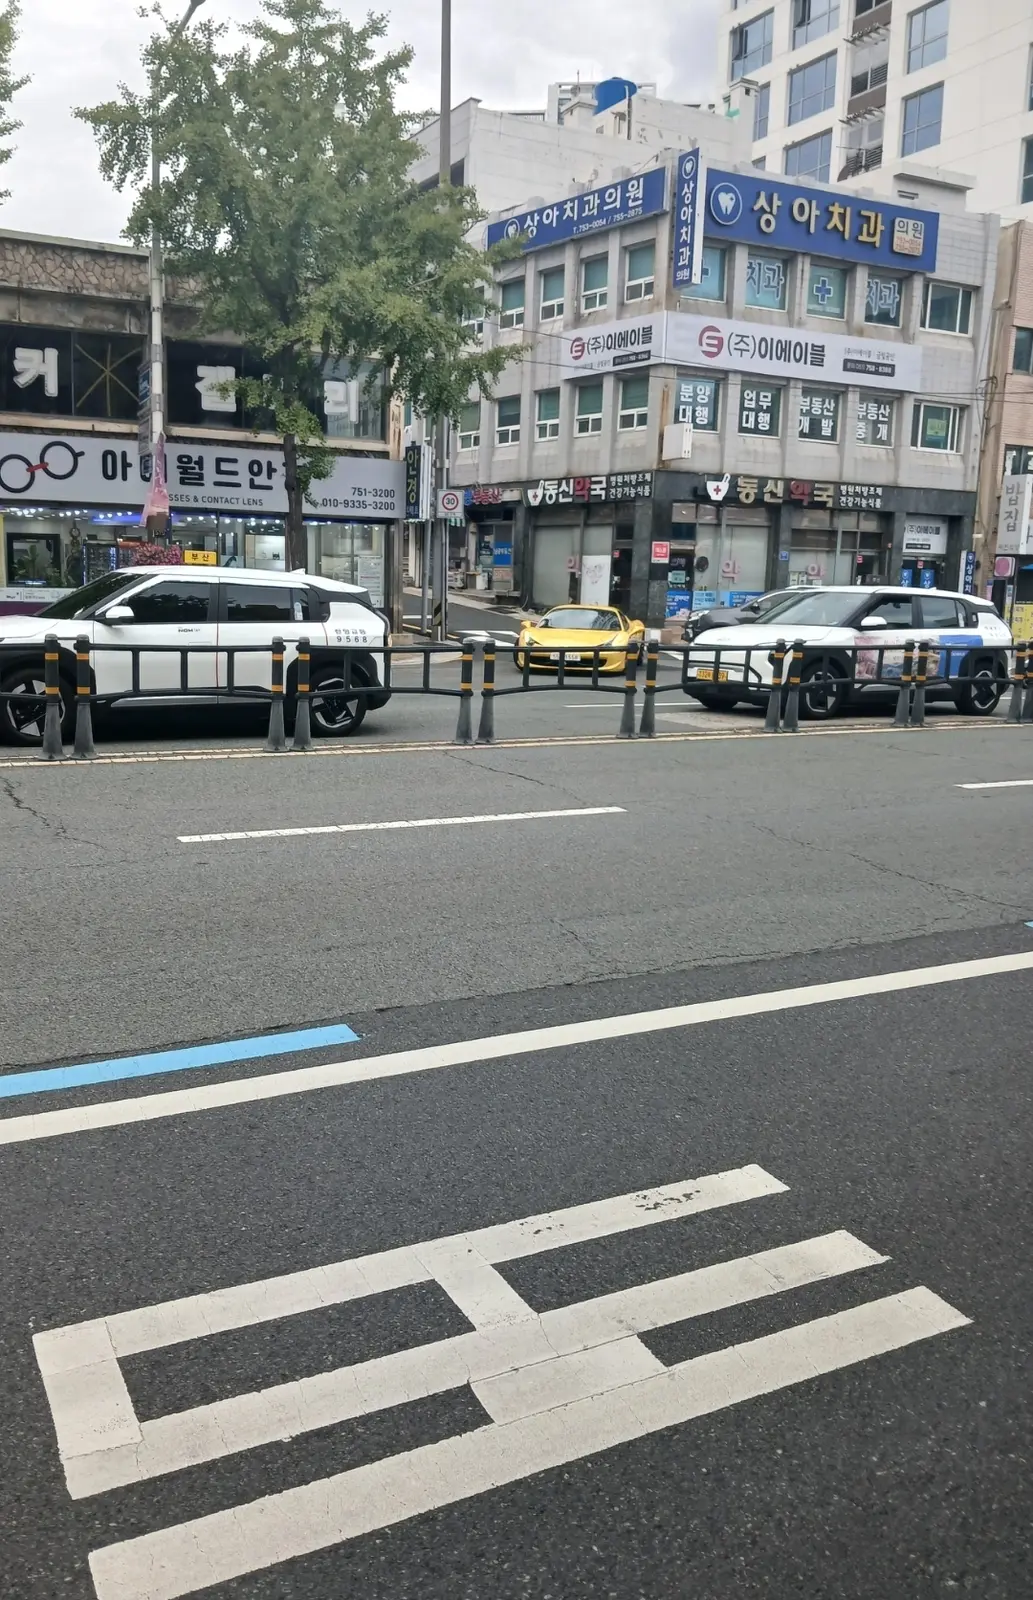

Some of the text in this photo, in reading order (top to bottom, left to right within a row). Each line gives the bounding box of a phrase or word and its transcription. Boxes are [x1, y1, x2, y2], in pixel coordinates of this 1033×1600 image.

[523, 178, 644, 238] 상아치과의원
[678, 181, 694, 266] 상아치과
[753, 190, 885, 248] 상아치과
[897, 220, 922, 239] 의원
[676, 268, 690, 281] 의원
[747, 260, 784, 300] 치과
[866, 279, 900, 319] 치과
[587, 325, 653, 355] (주)이에이블
[727, 332, 825, 367] (주)이에이블
[13, 347, 58, 397] 커
[680, 383, 711, 403] 분양
[744, 390, 772, 410] 업무
[679, 405, 709, 425] 대행
[800, 396, 835, 416] 부동산
[857, 402, 890, 421] 부동산
[742, 411, 771, 431] 대행
[101, 449, 288, 491] 아이월드안
[407, 449, 418, 503] 안경
[609, 473, 651, 487] 병원처방조제
[351, 487, 395, 498] 751-3200
[543, 476, 607, 504] 동신약국
[609, 485, 651, 499] 건강기능식품
[736, 476, 834, 508] 동신약국
[839, 484, 883, 497] 병원처방조제
[169, 494, 264, 507] SSES & CONTACT LENS
[445, 497, 455, 505] 30
[839, 498, 882, 509] 건강기능식품
[1003, 482, 1024, 533] 밥집
[191, 553, 209, 562] 부산
[722, 560, 740, 584] 약
